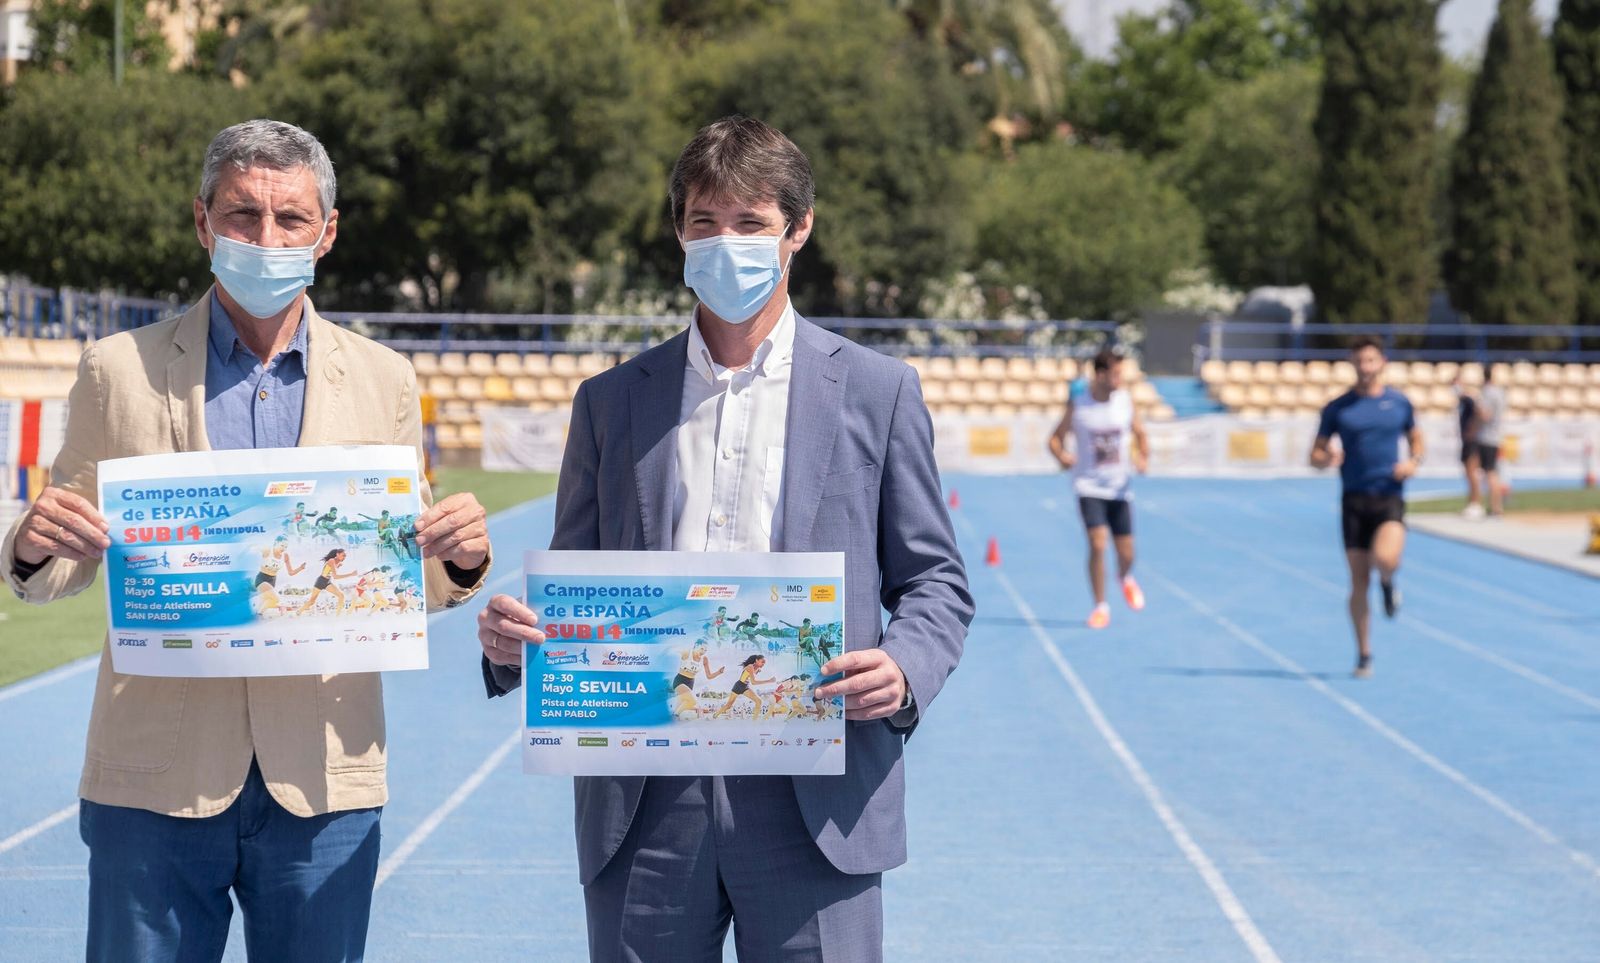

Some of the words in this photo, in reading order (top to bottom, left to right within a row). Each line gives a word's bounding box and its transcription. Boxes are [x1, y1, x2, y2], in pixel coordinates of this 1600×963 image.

[363, 477, 379, 485] IMD
[121, 484, 241, 502] Campeonato
[122, 508, 145, 521] de
[151, 502, 230, 520] ESPAÑA
[204, 526, 266, 535] INDIVIDUAL
[125, 587, 155, 598] Mayo
[161, 582, 230, 596] SEVILLA
[543, 583, 664, 600] Campeonato
[125, 601, 148, 610] Pista
[149, 602, 161, 610] de
[164, 601, 212, 610] Atletismo
[544, 605, 566, 617] de
[573, 602, 651, 618] ESPAÑA
[125, 612, 145, 620] SAN
[147, 612, 180, 620] PABLO
[608, 651, 649, 661] Generación
[542, 684, 574, 694] Mayo
[579, 681, 647, 694] SEVILLA
[541, 699, 565, 707] Pista
[567, 699, 579, 707] de
[581, 699, 629, 708] Atletismo
[564, 710, 597, 718] PABLO
